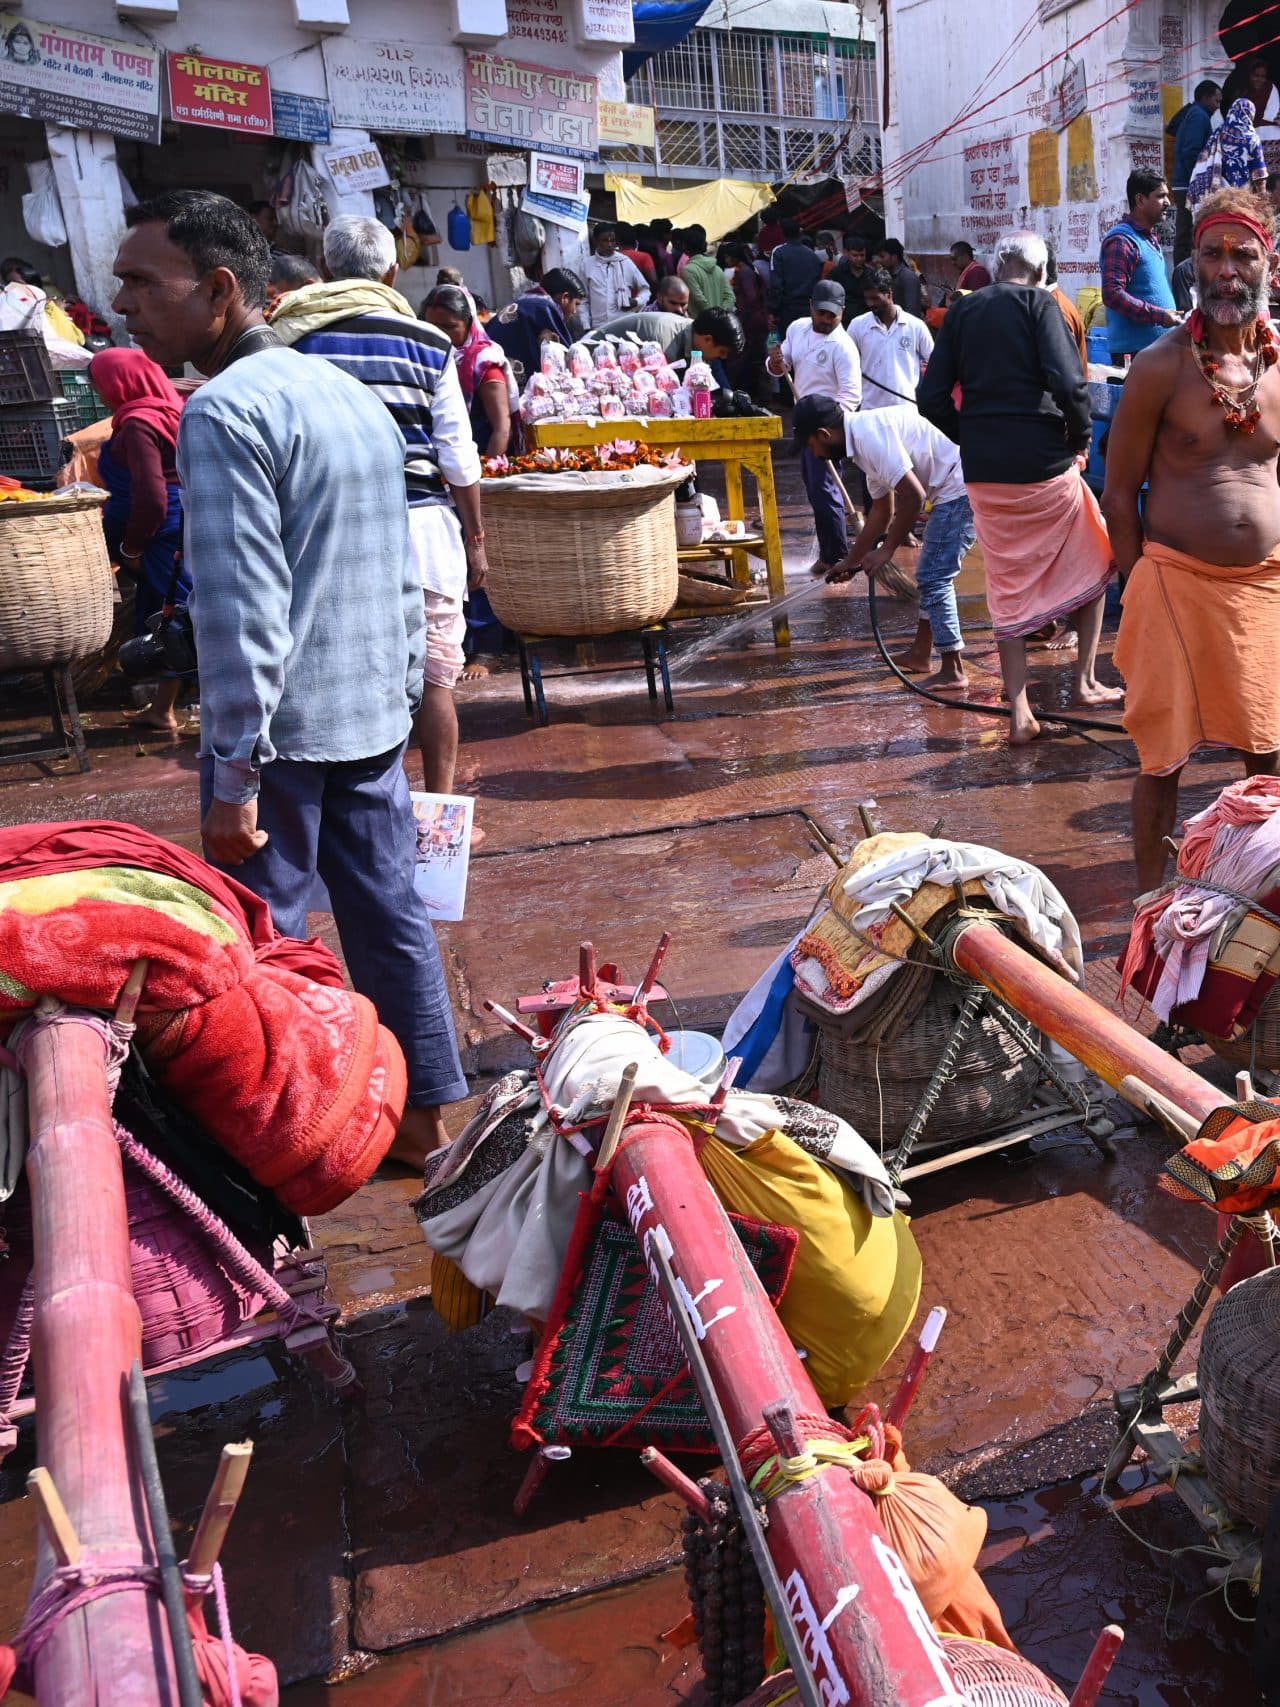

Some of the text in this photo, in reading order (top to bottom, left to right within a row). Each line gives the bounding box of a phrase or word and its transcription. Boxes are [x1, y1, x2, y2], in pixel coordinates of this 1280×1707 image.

[39, 29, 155, 79] गंगाराम पण्डा
[176, 56, 262, 87] नीलकंठ
[193, 83, 248, 106] मंदिर
[471, 87, 533, 137] नैना
[538, 102, 593, 148] पंडा
